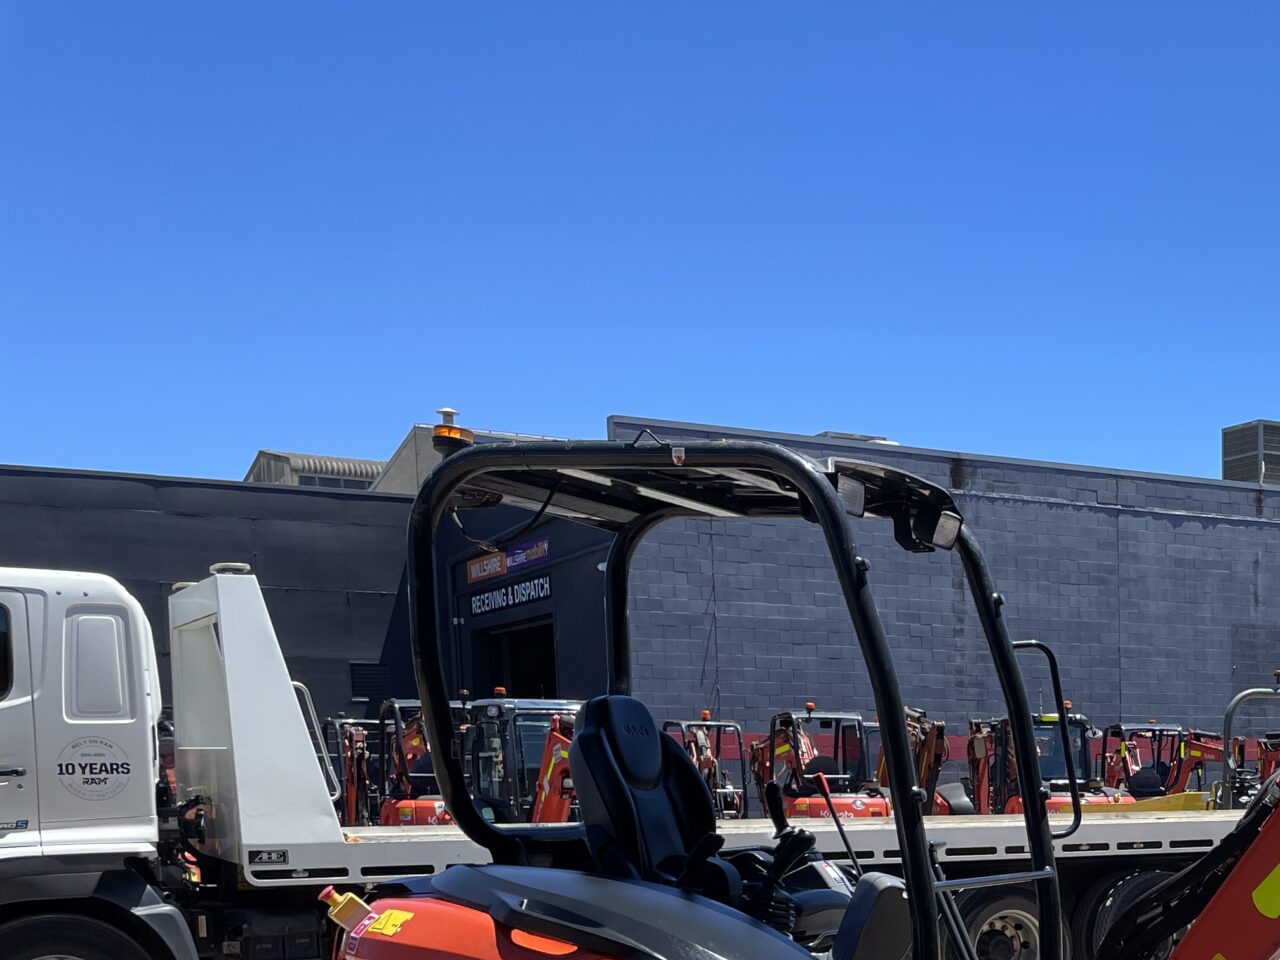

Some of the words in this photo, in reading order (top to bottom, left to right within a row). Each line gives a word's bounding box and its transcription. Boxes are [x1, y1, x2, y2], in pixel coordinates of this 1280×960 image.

[471, 588, 507, 615] RECEIVING
[507, 586, 514, 606] &
[514, 576, 550, 603] DISPATCH
[57, 763, 76, 776] 10
[78, 762, 131, 775] YEARS
[82, 777, 109, 785] RAM
[820, 810, 854, 818] Kuota
